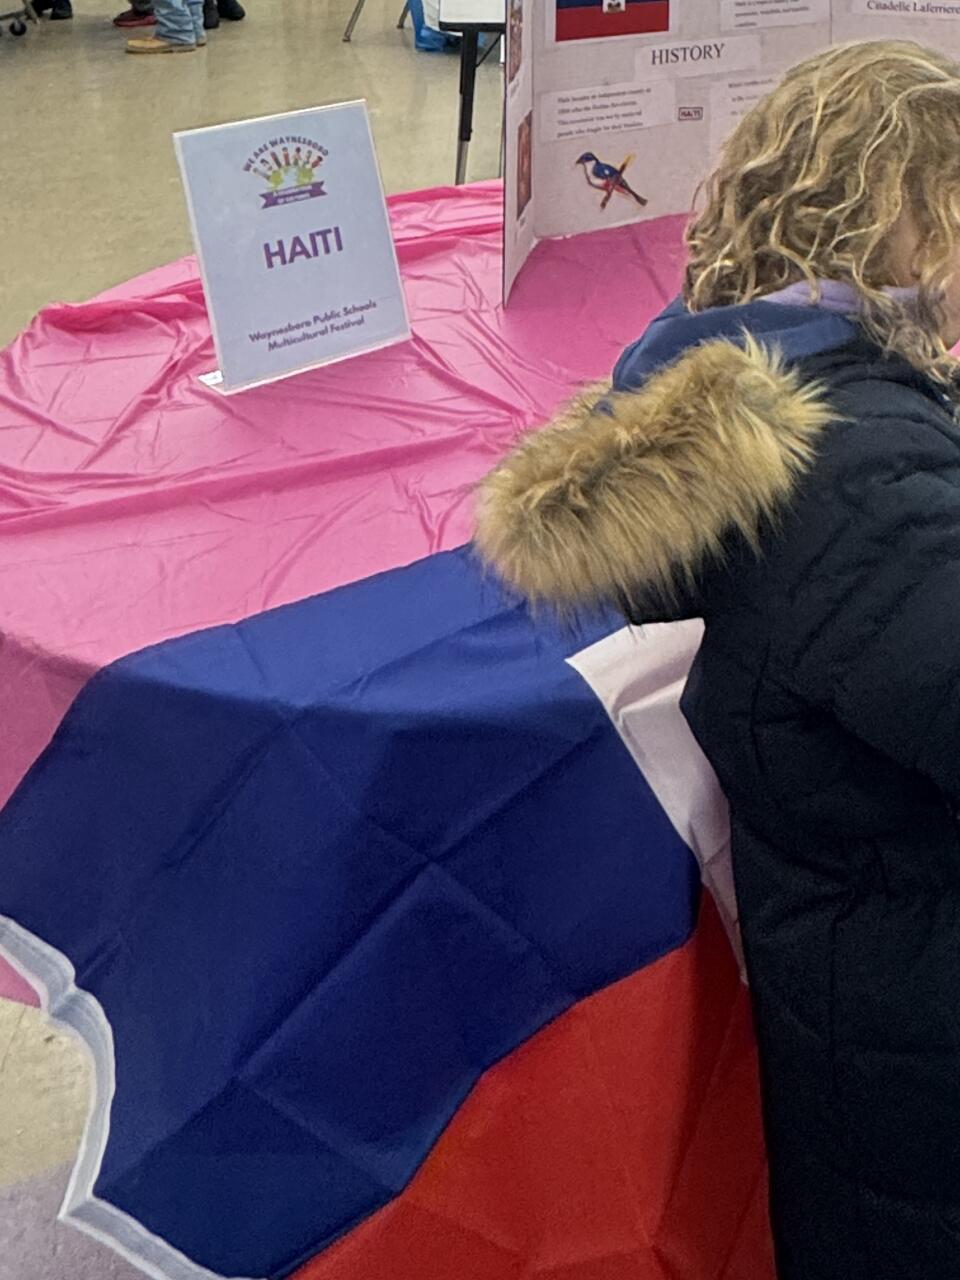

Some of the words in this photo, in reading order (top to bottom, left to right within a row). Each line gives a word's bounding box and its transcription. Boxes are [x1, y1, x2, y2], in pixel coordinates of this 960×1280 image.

[651, 43, 725, 66] HISTORY
[268, 135, 329, 157] WAYNESBORO
[263, 226, 344, 269] HAITI
[248, 319, 313, 342] Waynesboro
[312, 309, 342, 325] Public
[342, 299, 377, 317] Schools
[267, 325, 329, 351] Multicultural
[329, 314, 366, 334] Festival
